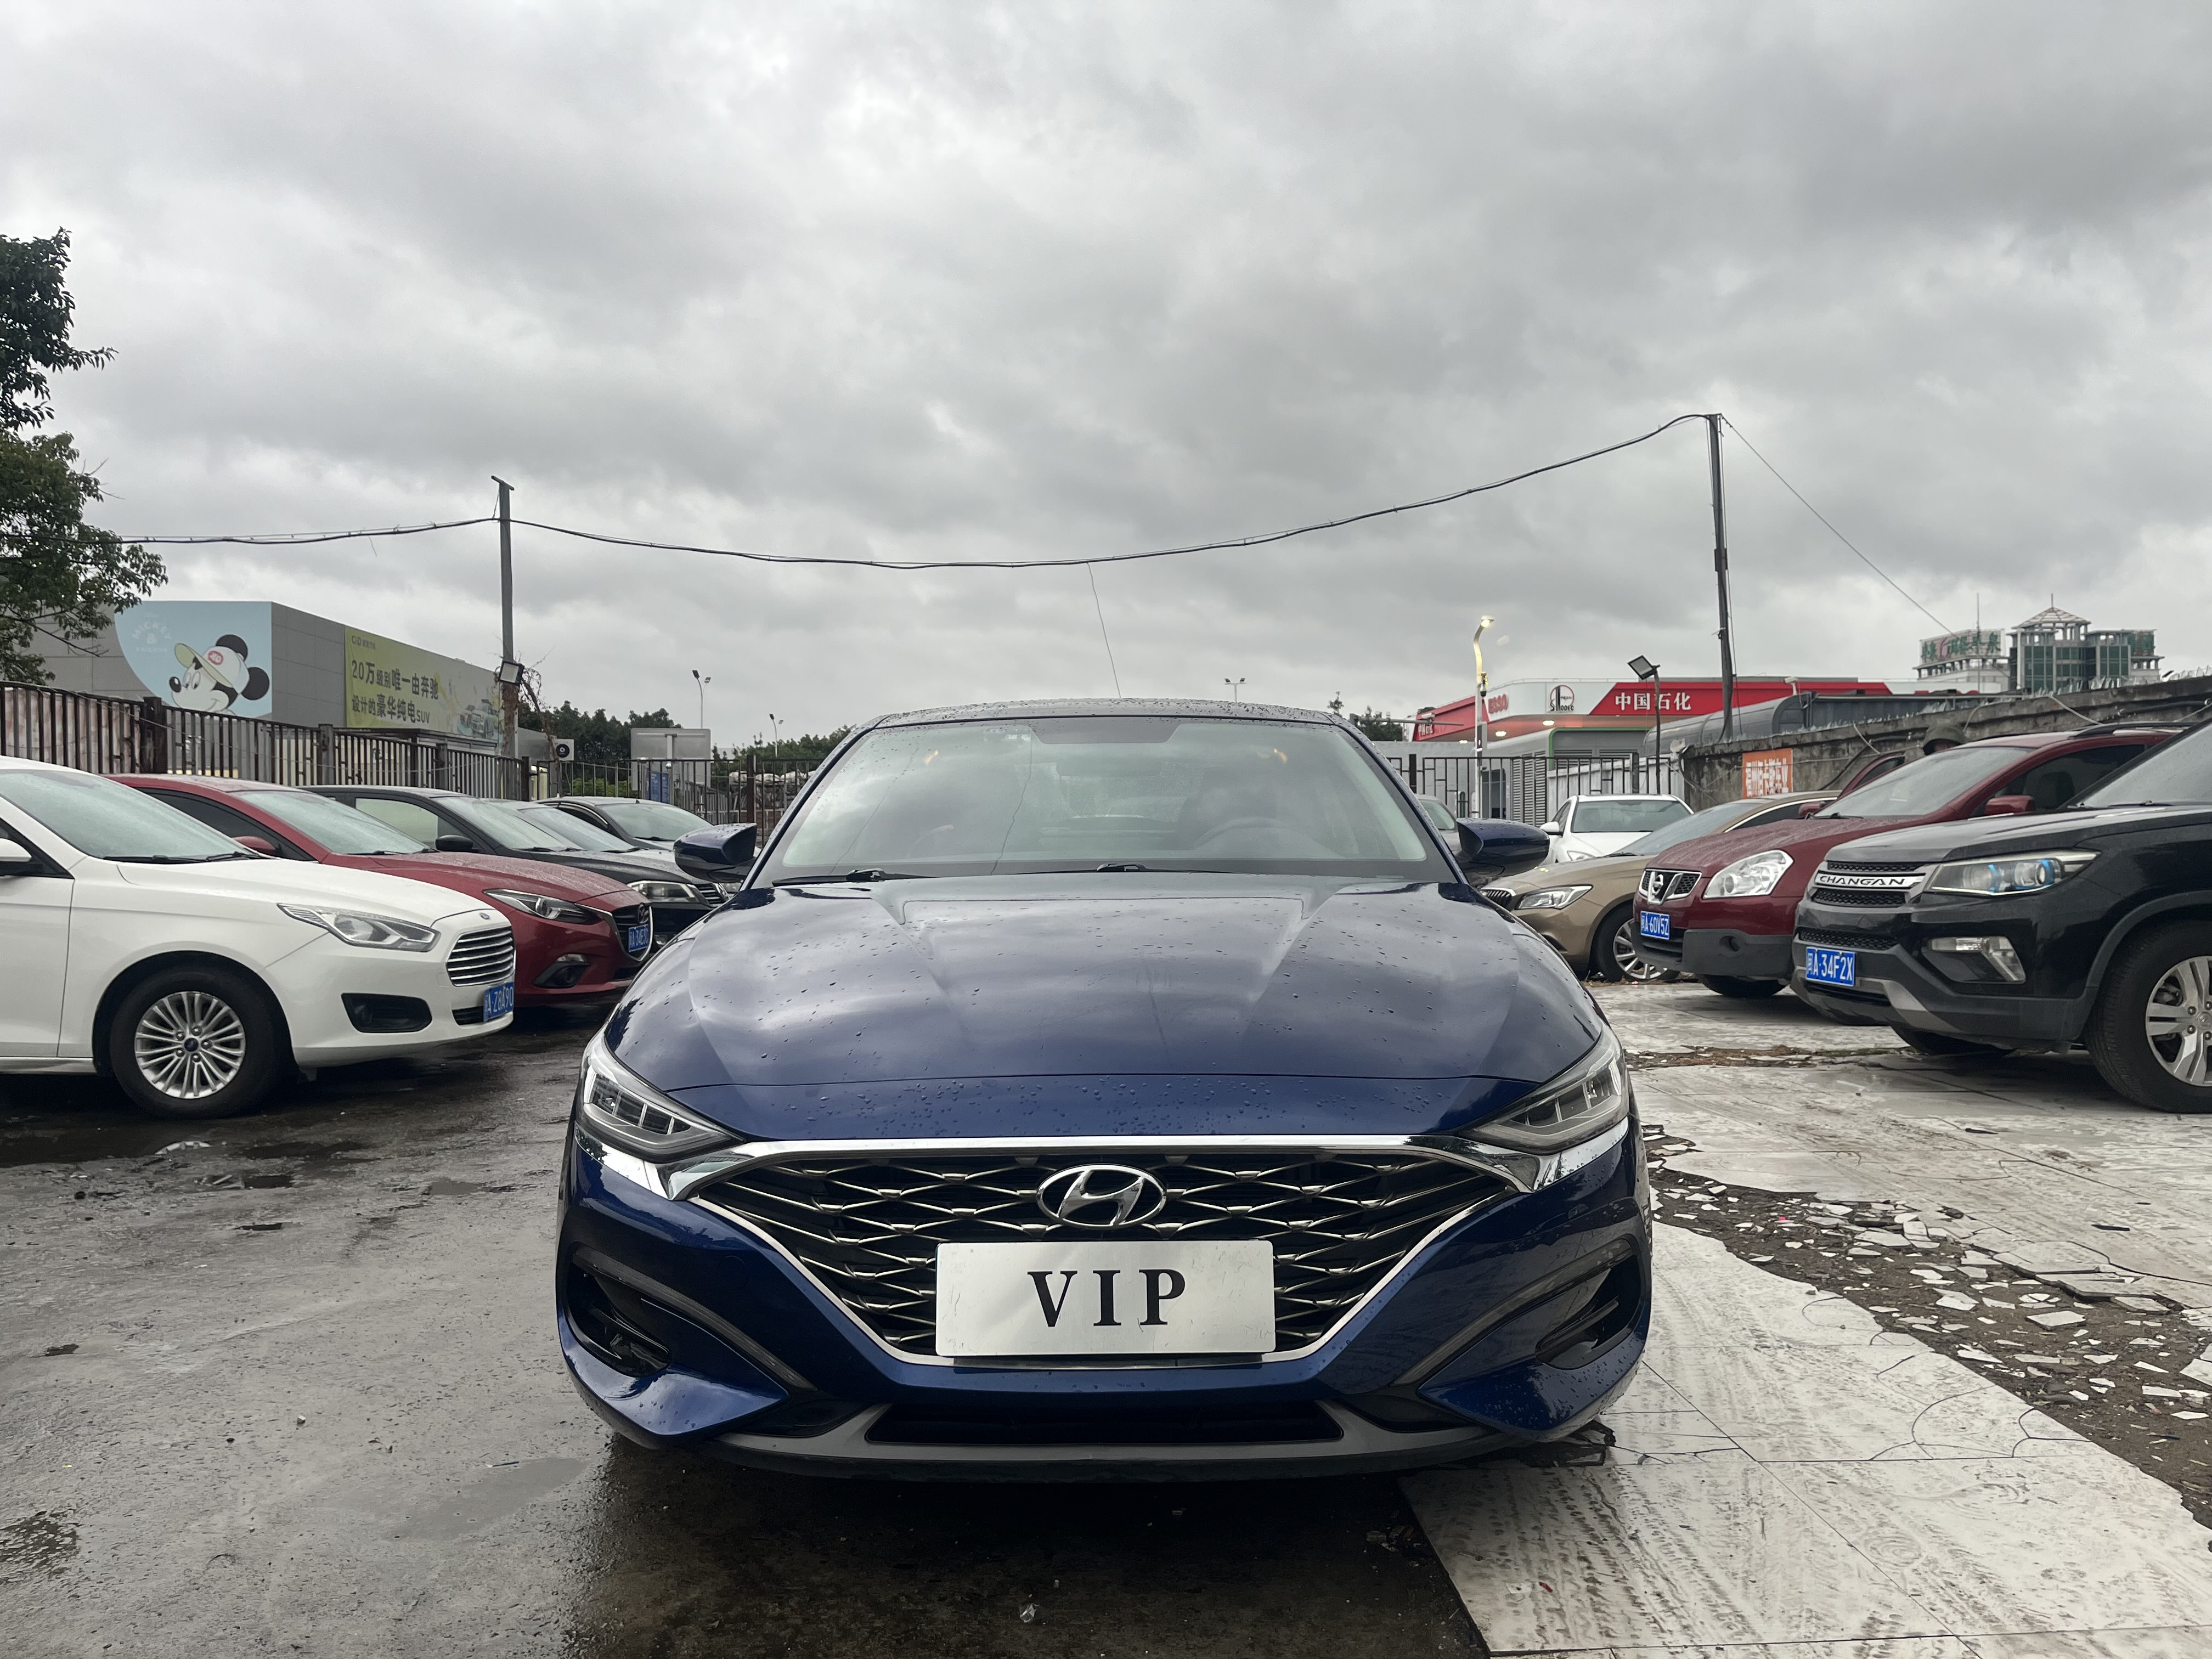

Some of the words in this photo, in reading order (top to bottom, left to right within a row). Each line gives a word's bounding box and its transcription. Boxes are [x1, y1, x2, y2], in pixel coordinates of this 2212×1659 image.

[352, 659, 438, 699] 20万级别唯一由奔驰
[352, 693, 430, 724] 设计的豪华纯电SUV
[1615, 692, 1691, 710] 中国石化
[1820, 876, 1905, 885] CHANGAN
[1027, 1268, 1186, 1328] VIP
